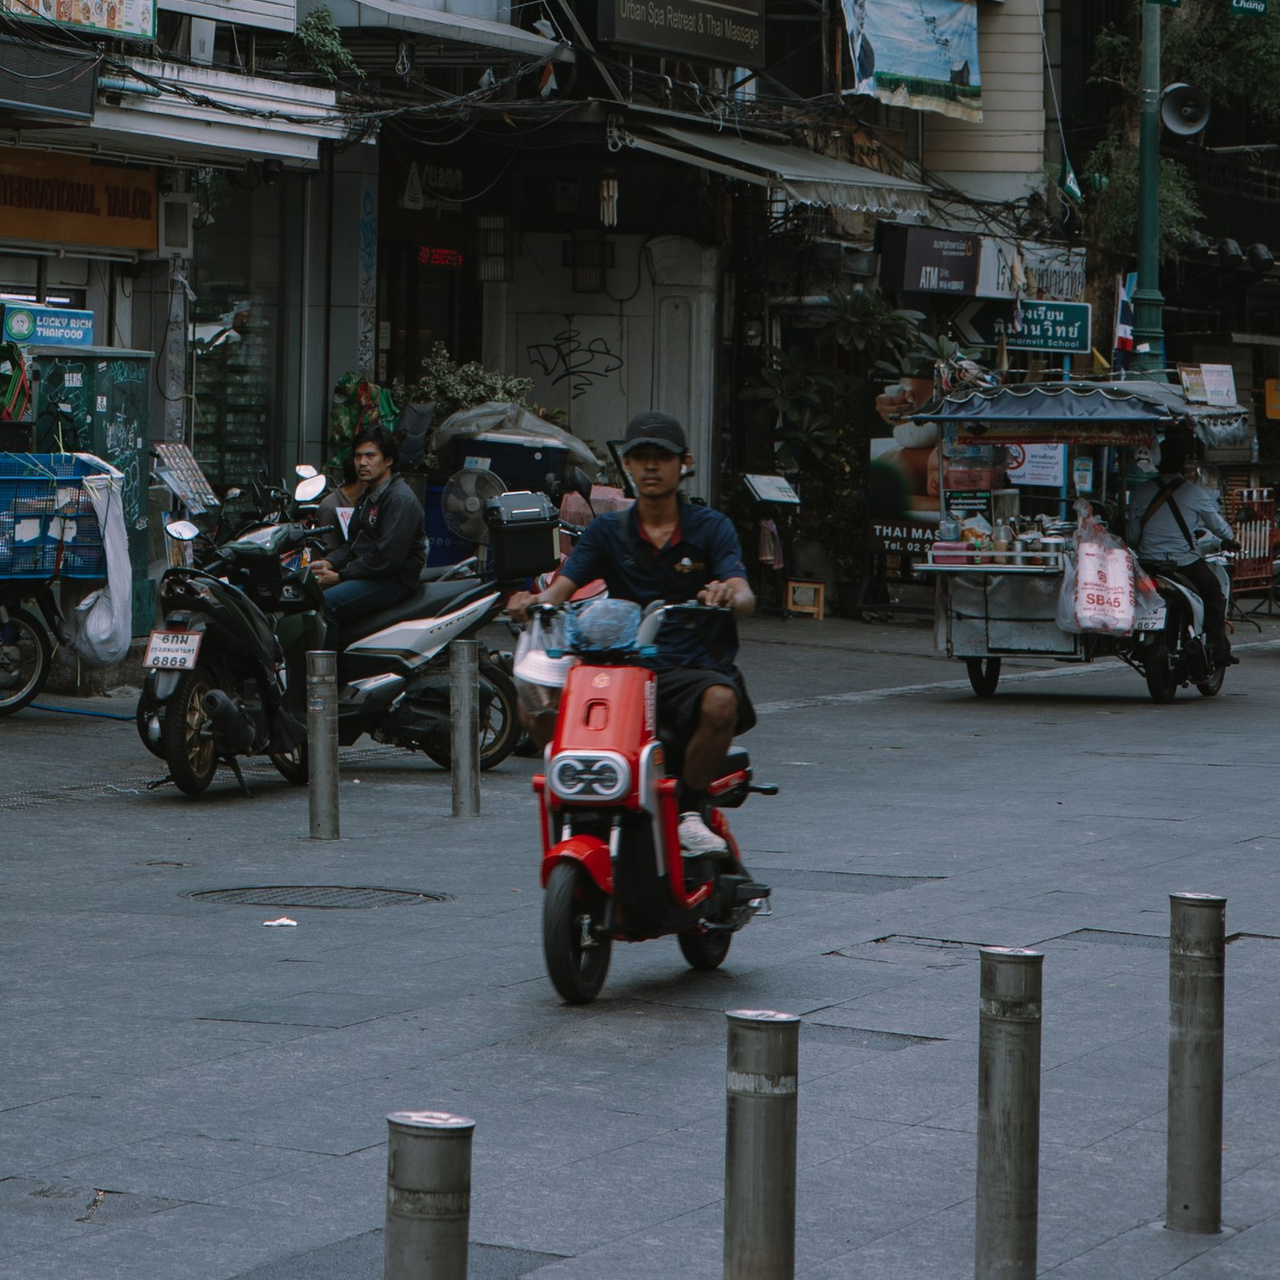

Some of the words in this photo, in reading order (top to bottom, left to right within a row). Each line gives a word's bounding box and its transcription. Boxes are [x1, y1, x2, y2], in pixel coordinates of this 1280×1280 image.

[648, 1, 665, 28] Spa
[666, 6, 697, 32] Retreat
[697, 14, 704, 33] &
[706, 13, 724, 36] Thai
[725, 18, 760, 49] Massage
[920, 265, 939, 290] ATM
[36, 315, 68, 328] LUCKY
[70, 318, 92, 329] RICH
[36, 327, 84, 339] THAIFOOD
[1047, 338, 1080, 348] School
[874, 525, 907, 538] THAI
[883, 540, 904, 551] Tel.
[907, 541, 920, 552] 02
[1086, 593, 1121, 608] SB45
[152, 656, 187, 667] 6869
